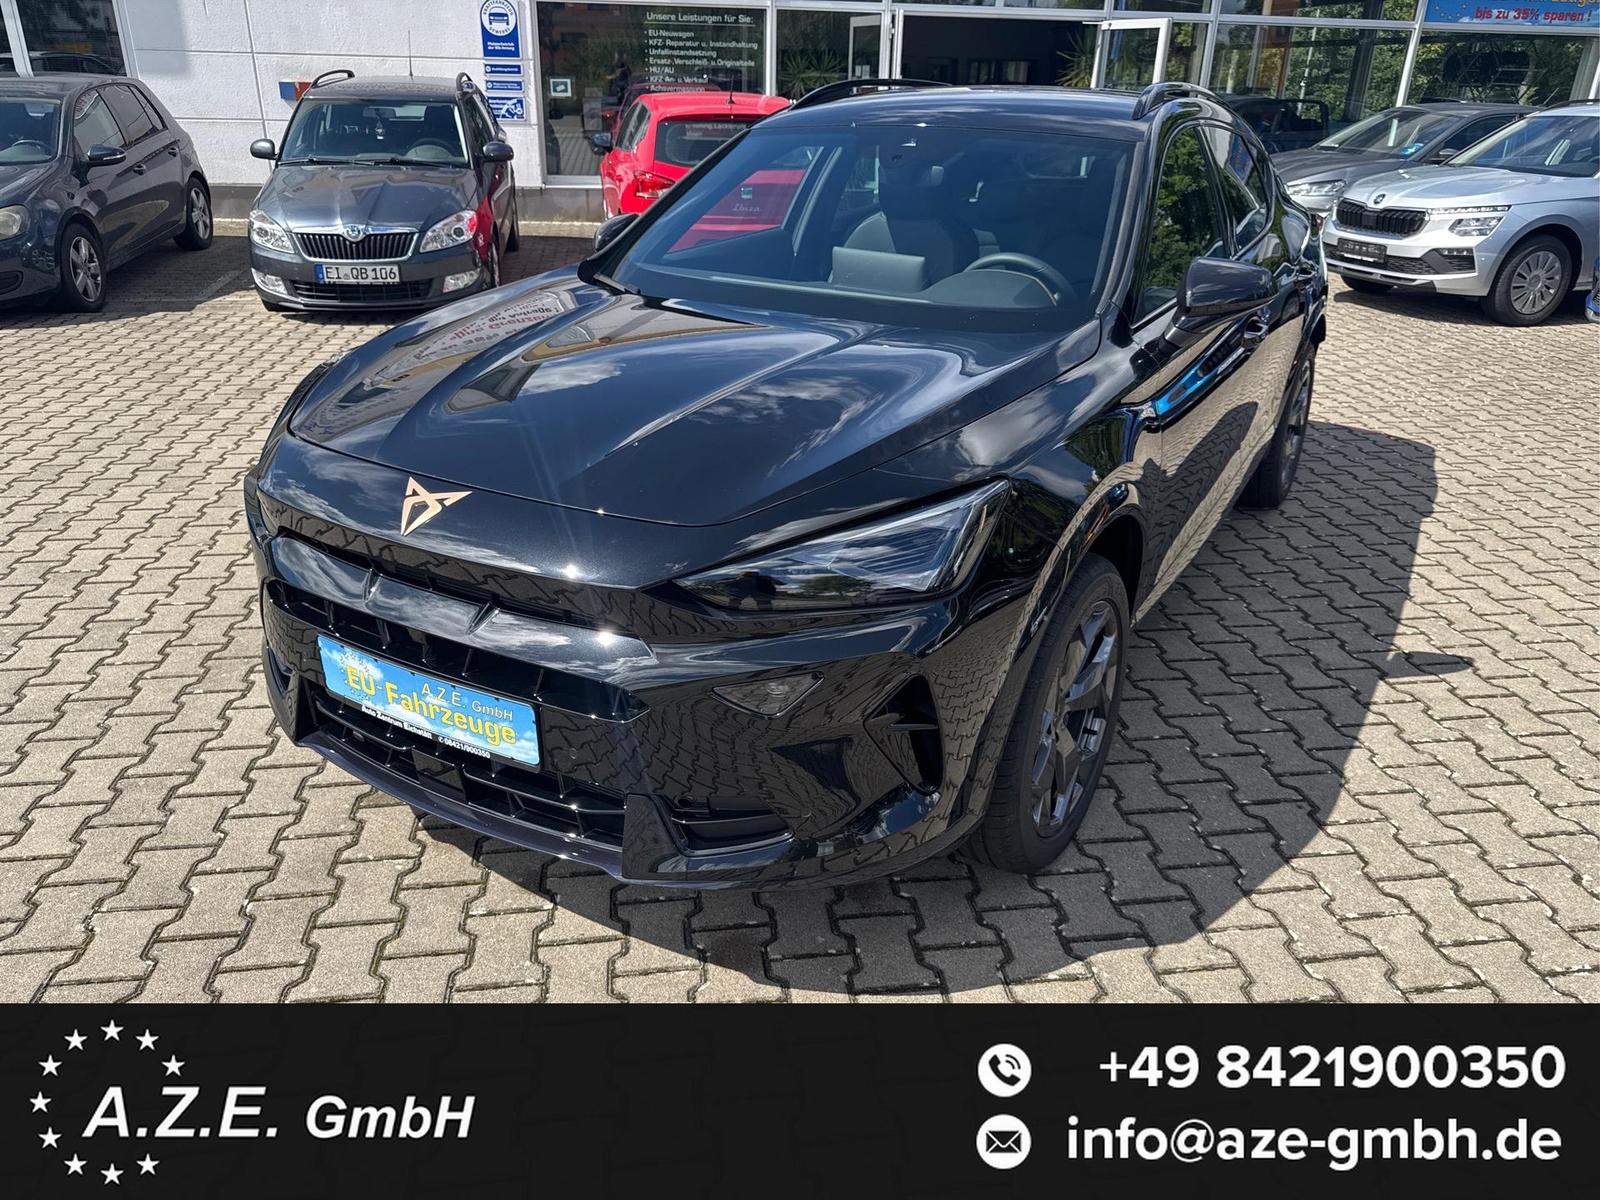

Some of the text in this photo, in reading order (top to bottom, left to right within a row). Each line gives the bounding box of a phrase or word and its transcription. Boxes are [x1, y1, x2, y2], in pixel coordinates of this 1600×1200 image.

[646, 12, 754, 24] Unsere Leistungen für Sie:
[1475, 8, 1492, 20] bis
[1496, 10, 1509, 20] zu
[1543, 11, 1584, 23] sparen
[648, 29, 694, 38] EU-Neuwagen
[709, 40, 758, 50] Instandhaltung
[649, 49, 717, 58] Unfallinstandsetzung
[649, 66, 675, 74] HU/AU
[325, 266, 397, 280] EI QB 106
[471, 700, 514, 721] GmbH
